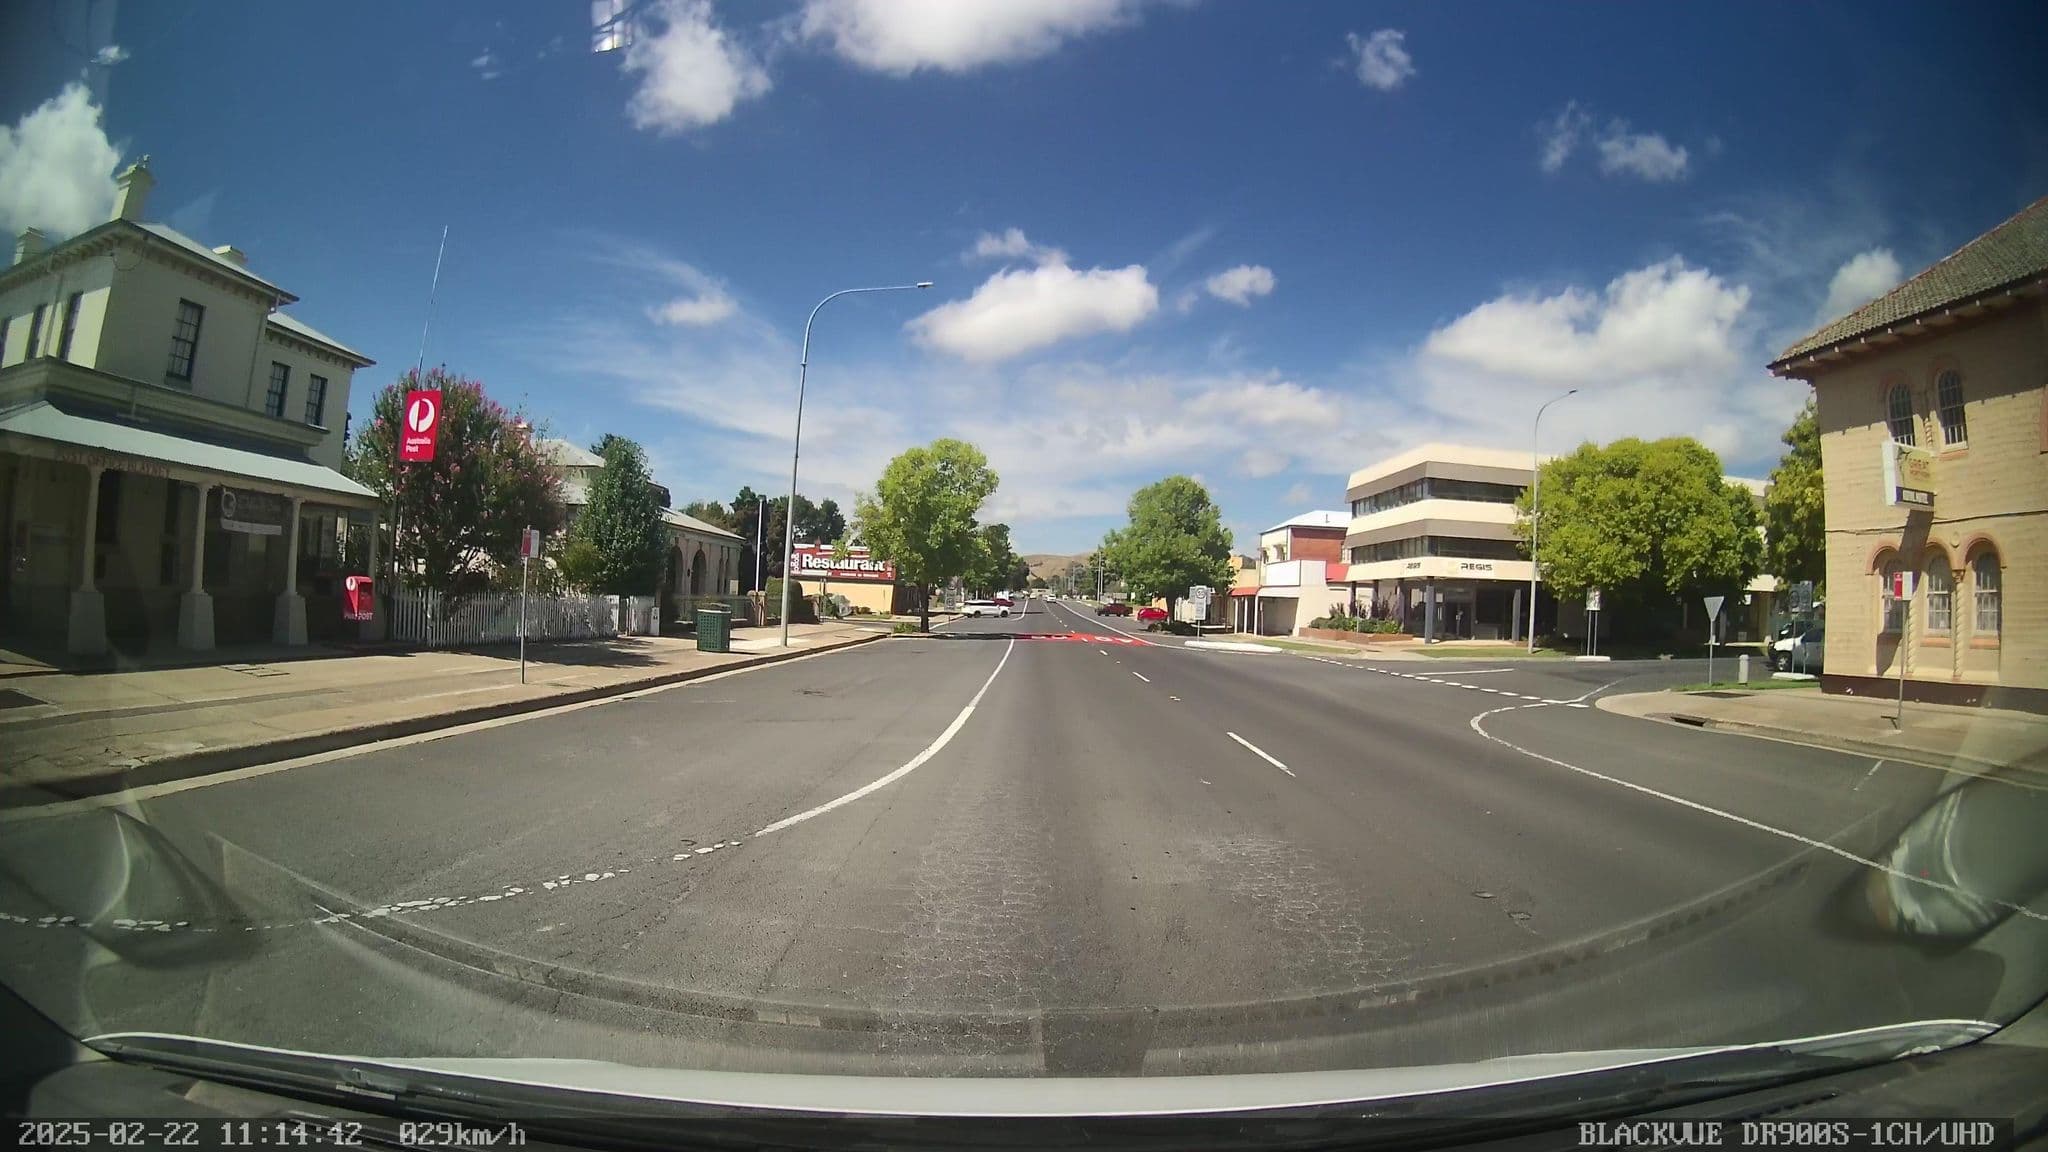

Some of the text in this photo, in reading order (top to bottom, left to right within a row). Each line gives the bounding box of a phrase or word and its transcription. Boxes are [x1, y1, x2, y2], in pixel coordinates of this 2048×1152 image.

[406, 445, 419, 453] Post
[802, 553, 885, 571] Restaurant
[1461, 563, 1493, 571] REGIS
